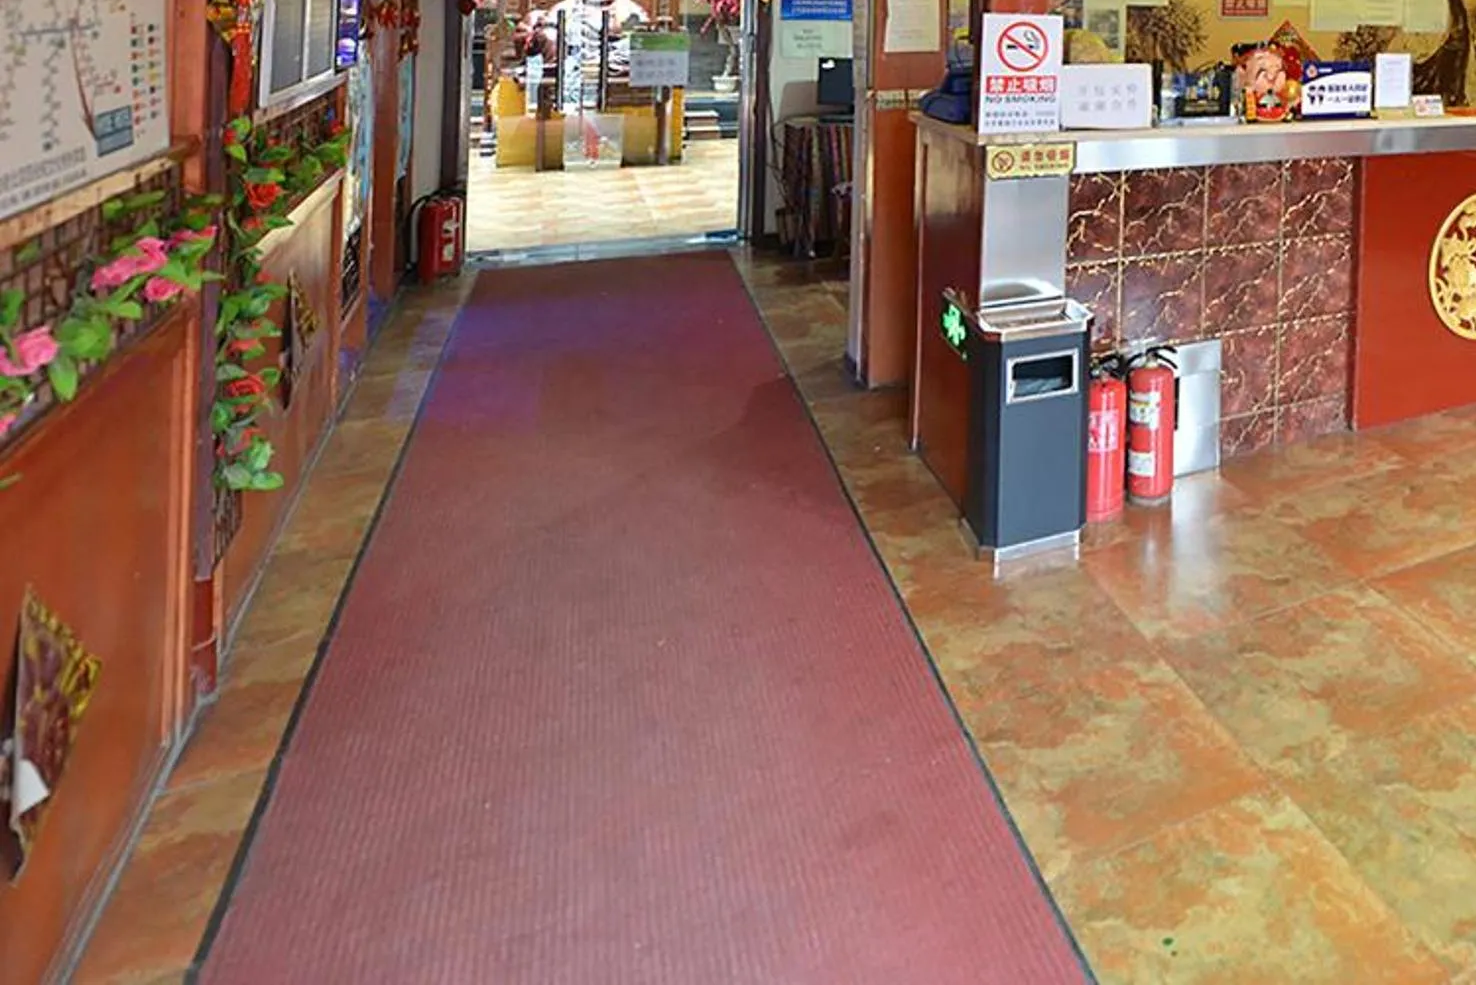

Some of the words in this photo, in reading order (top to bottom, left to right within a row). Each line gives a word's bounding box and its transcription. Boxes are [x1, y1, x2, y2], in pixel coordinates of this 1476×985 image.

[989, 76, 1055, 93] 禁止吸烟
[1006, 95, 1056, 103] SMOKING
